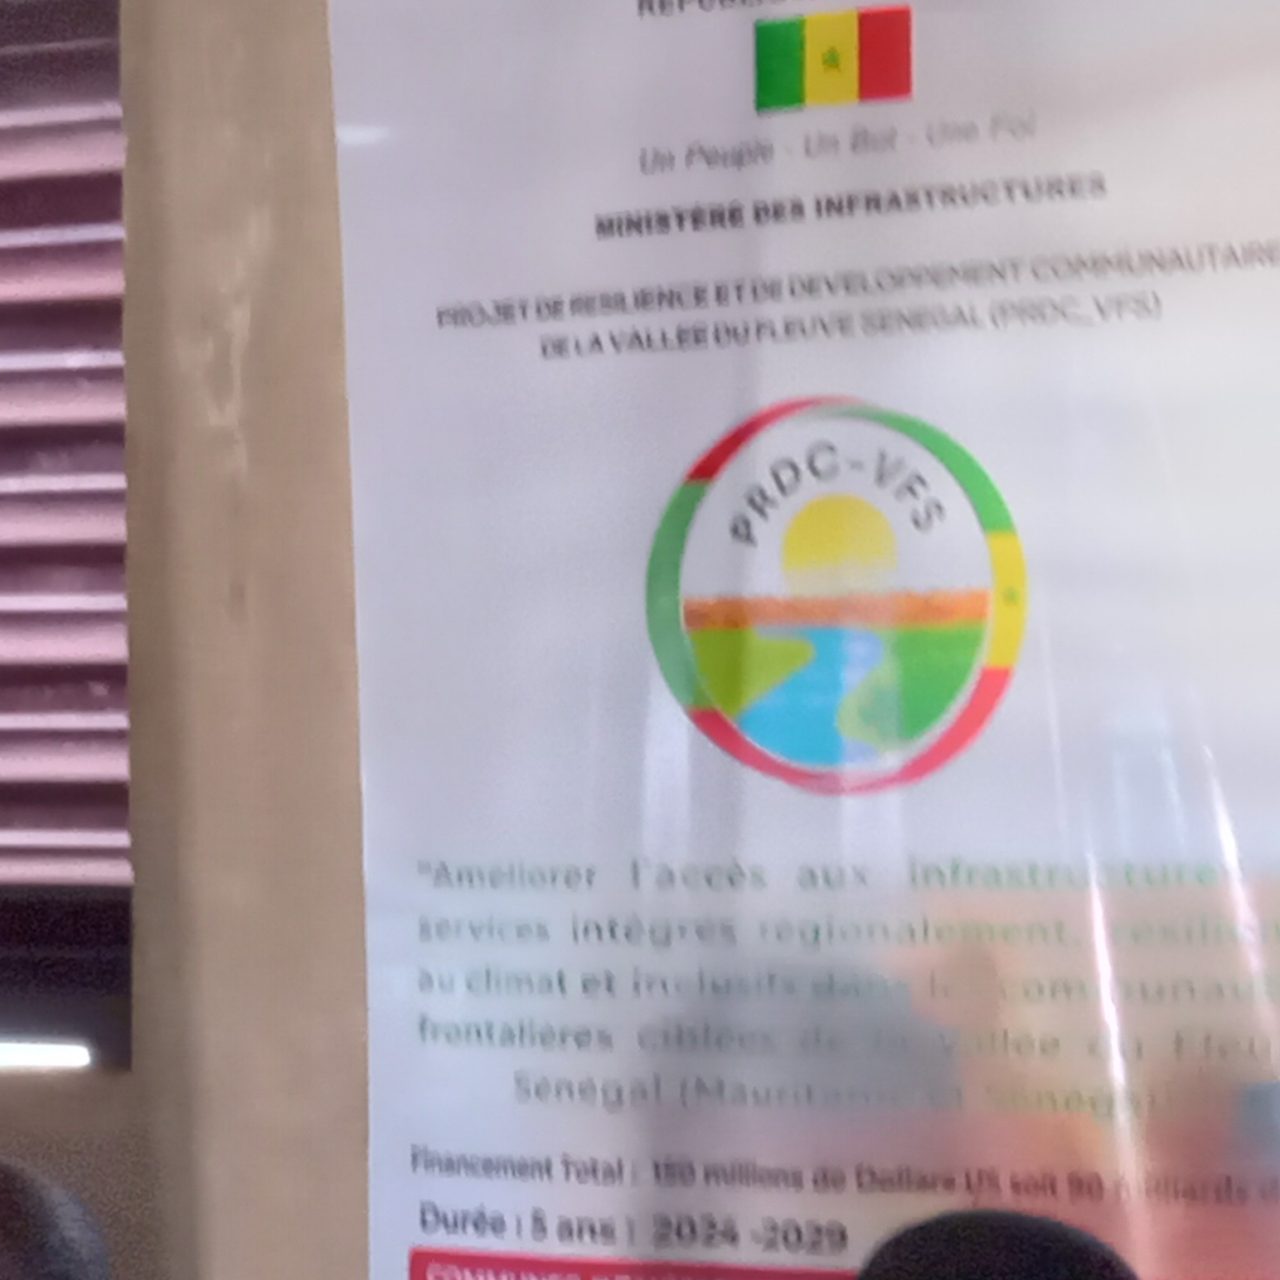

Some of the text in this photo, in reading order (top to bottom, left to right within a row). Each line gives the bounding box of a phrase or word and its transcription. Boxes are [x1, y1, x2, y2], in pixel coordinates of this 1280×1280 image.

[752, 194, 805, 226] DES
[816, 169, 1107, 219] INFRASTRUCTURES
[436, 298, 529, 329] PROJET
[535, 293, 565, 321] DE
[715, 281, 744, 307] ET
[751, 276, 782, 303] DE
[540, 332, 569, 360] DE
[575, 328, 603, 357] LA
[714, 319, 749, 348] DU
[756, 308, 856, 342] FLEUVE
[797, 863, 868, 889] aux
[418, 913, 551, 944] services
[419, 969, 455, 995] au
[465, 966, 567, 998] climat
[580, 968, 616, 998] et
[409, 1143, 553, 1184] Financement
[702, 1158, 805, 1191] millions
[812, 1163, 847, 1191] de
[418, 1199, 507, 1238] Durée
[556, 1215, 617, 1246] ans
